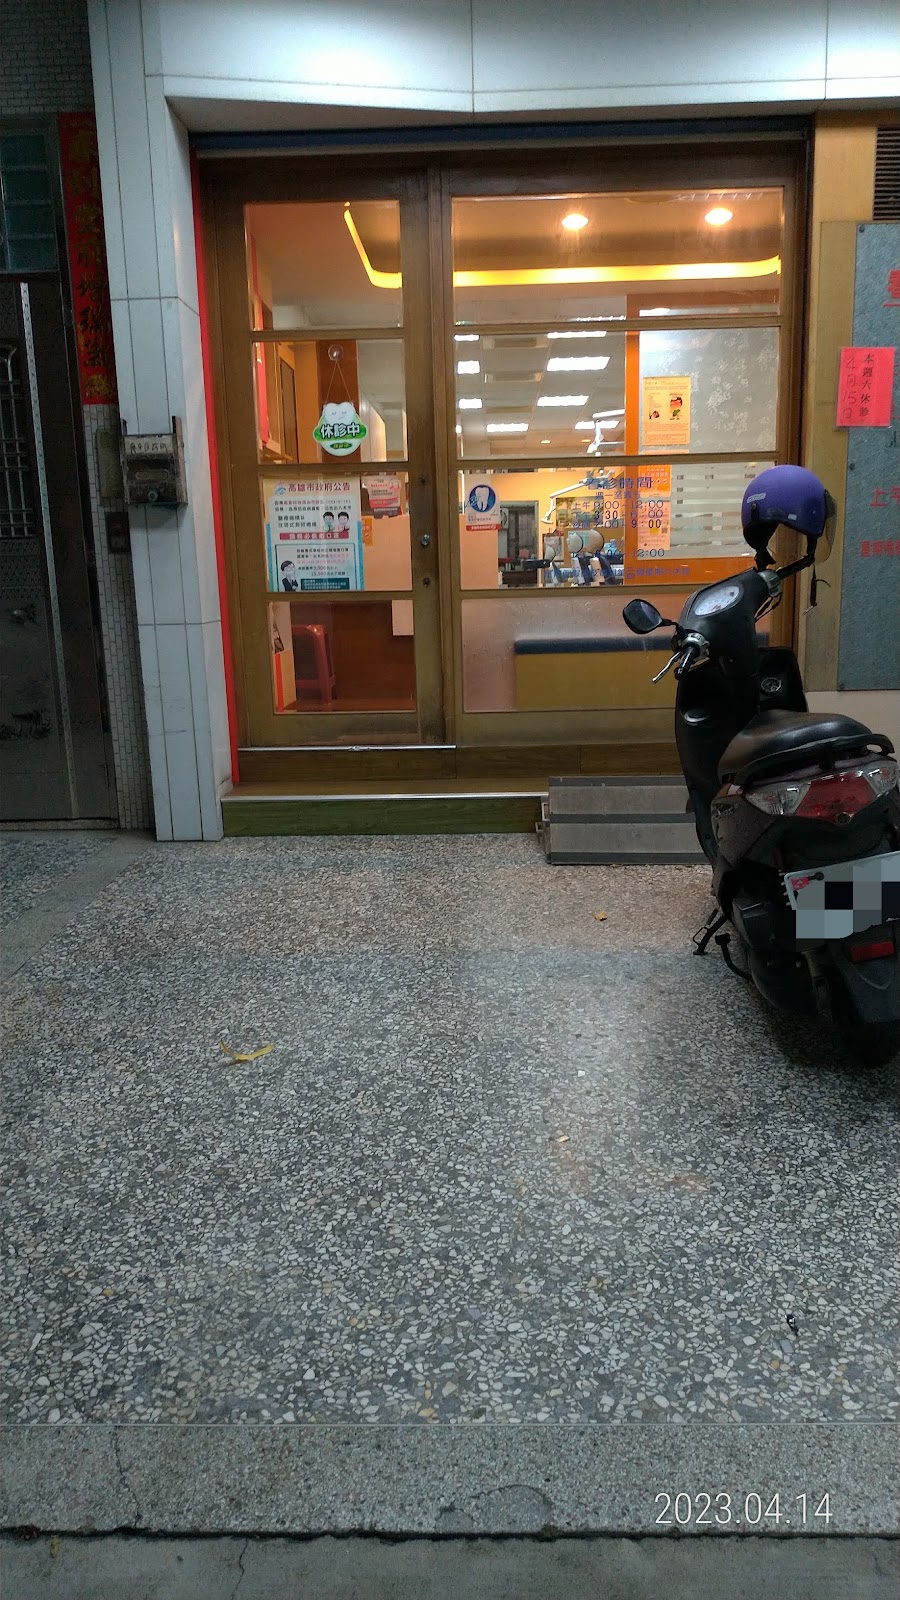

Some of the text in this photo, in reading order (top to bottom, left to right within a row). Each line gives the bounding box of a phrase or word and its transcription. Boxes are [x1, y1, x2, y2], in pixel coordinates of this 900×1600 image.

[841, 356, 858, 419] 4月15日
[858, 352, 875, 417] 本週六休診
[320, 422, 360, 439] 休診中
[288, 480, 351, 493] 高雄市政府公告
